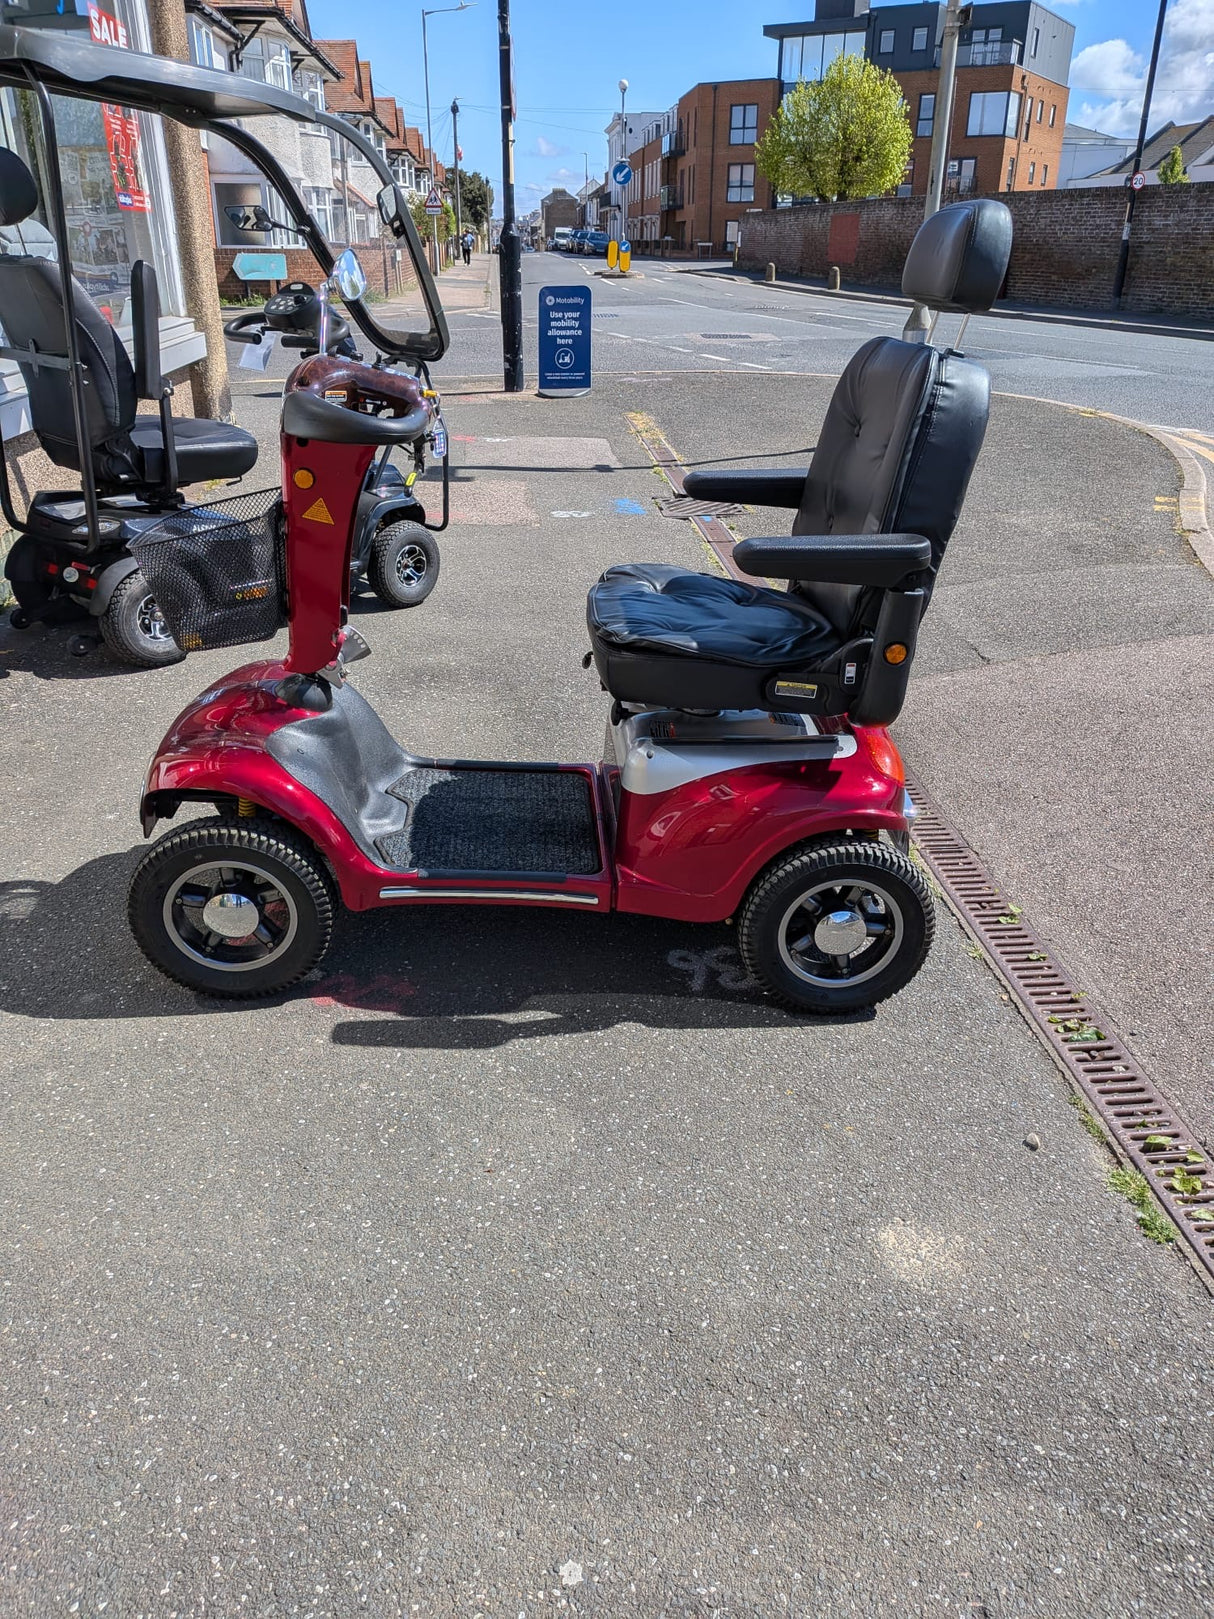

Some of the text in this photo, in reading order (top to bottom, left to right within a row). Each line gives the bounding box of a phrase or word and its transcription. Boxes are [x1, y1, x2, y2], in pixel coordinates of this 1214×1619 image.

[90, 8, 129, 49] SALE
[1133, 177, 1143, 185] 20
[555, 297, 585, 305] Motobility
[564, 311, 580, 320] your
[550, 319, 580, 328] mobility
[547, 328, 582, 336] allowance
[556, 337, 573, 345] here
